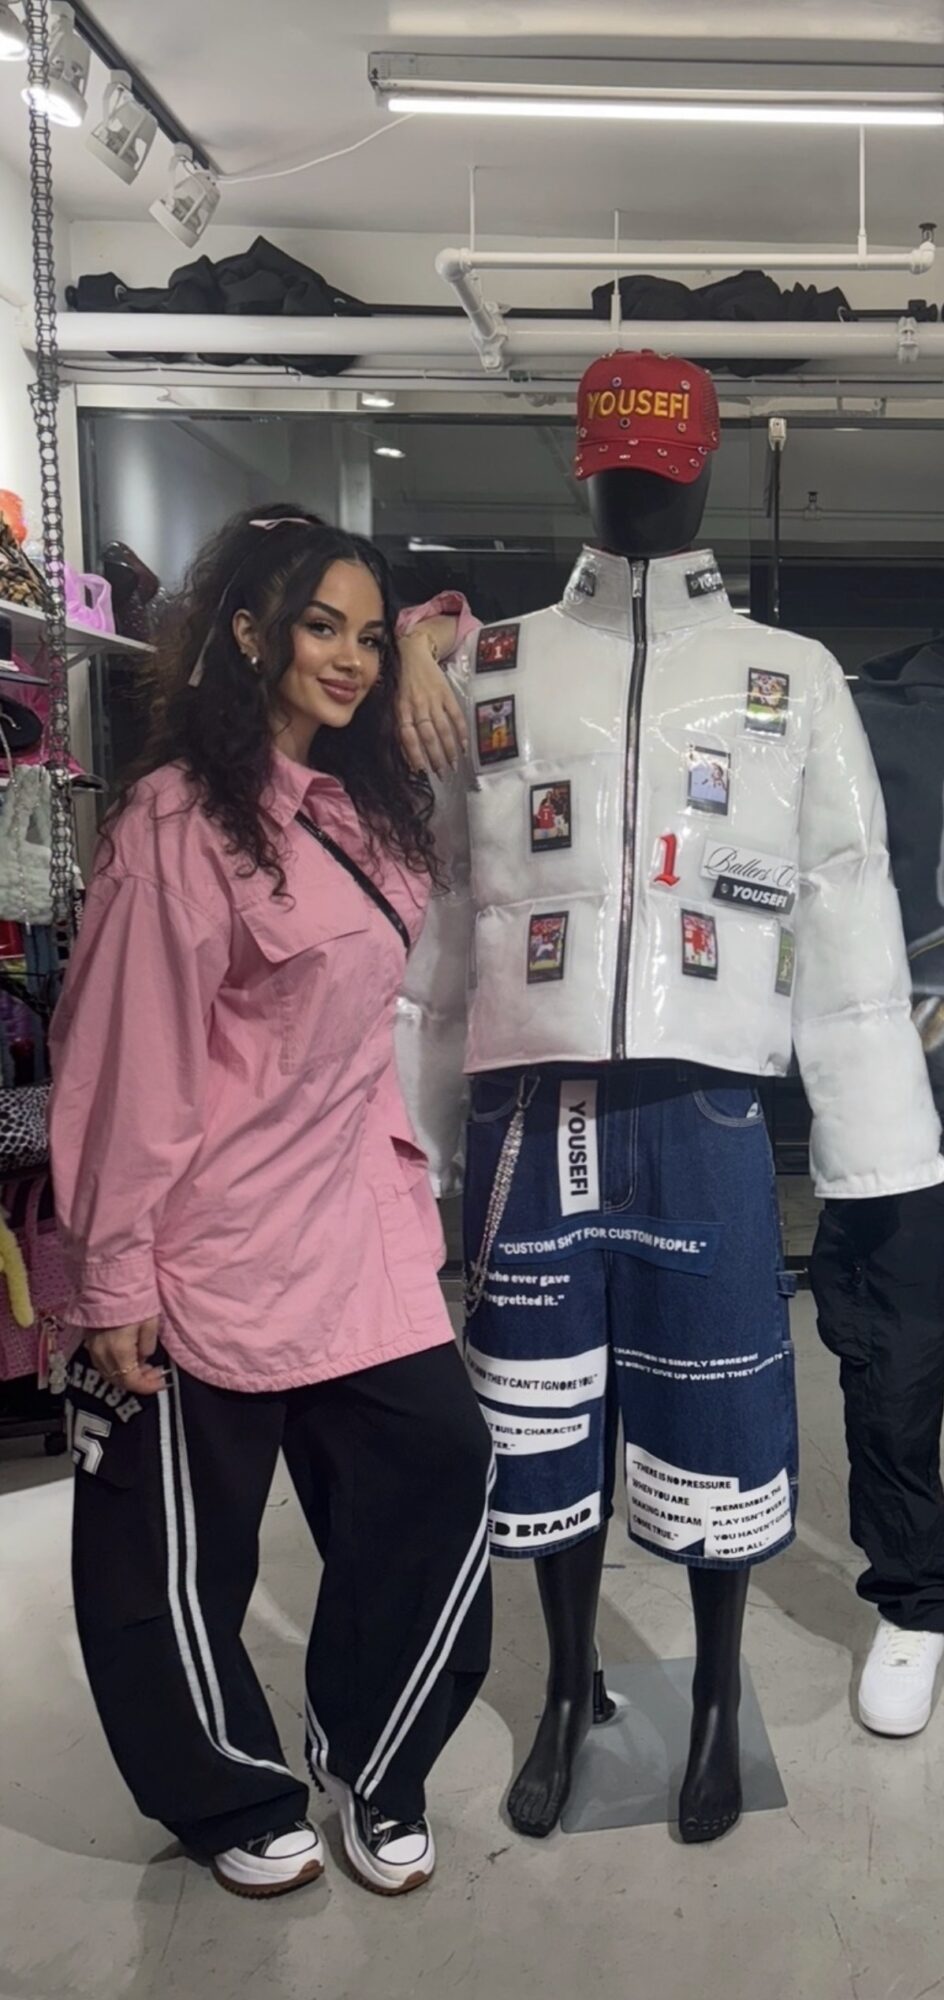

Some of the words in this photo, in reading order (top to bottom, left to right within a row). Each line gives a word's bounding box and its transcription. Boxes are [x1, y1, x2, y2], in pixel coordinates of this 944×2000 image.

[586, 388, 690, 420] YOUSEFI
[704, 846, 772, 881] Ballers
[732, 884, 788, 908] YOUSEFI
[568, 1100, 589, 1196] YOUSEFI
[584, 1227, 607, 1240] FOR
[608, 1228, 653, 1246] CUSTOM
[511, 1275, 538, 1284] ever
[540, 1274, 570, 1287] gave
[668, 1358, 709, 1368] SIMPLY
[487, 1371, 508, 1386] THEY
[509, 1378, 540, 1390] CAN'T
[541, 1380, 578, 1391] IGNORE
[689, 1372, 725, 1381] WHEN
[727, 1368, 754, 1378] THEY
[495, 1424, 522, 1435] BUILD
[524, 1423, 583, 1436] CHARACTER
[658, 1472, 666, 1481] IS
[667, 1476, 680, 1485] NO
[681, 1479, 732, 1489] PRESSURE
[632, 1478, 652, 1495] WHEN
[653, 1489, 670, 1501] YOU
[671, 1496, 690, 1506] ARE
[632, 1496, 659, 1516] MAKING
[667, 1514, 702, 1526] DREAM
[516, 1507, 592, 1537] BRAND
[632, 1514, 652, 1531] COME
[712, 1518, 739, 1527] PLAY
[713, 1532, 736, 1541] YOU
[715, 1546, 744, 1556] YOUR
